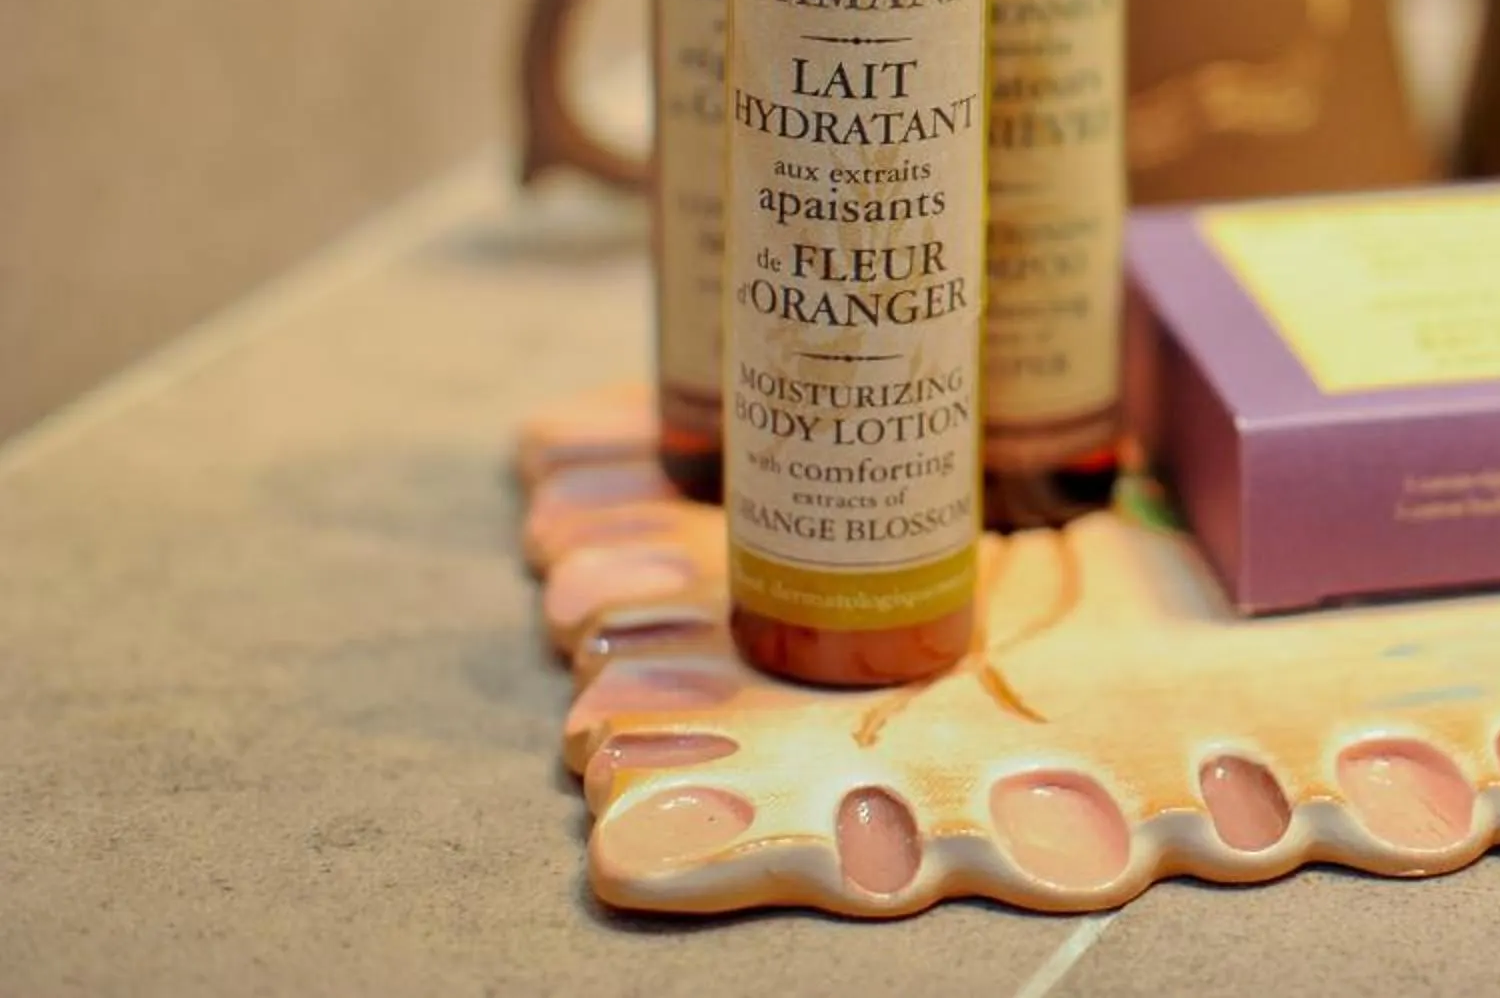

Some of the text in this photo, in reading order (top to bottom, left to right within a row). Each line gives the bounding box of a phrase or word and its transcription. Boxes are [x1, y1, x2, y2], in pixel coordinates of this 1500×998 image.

[792, 57, 918, 100] LAIT
[734, 88, 977, 146] HYDRATANT
[774, 159, 933, 185] aux extraits
[758, 186, 947, 228] apaisants
[757, 247, 782, 273] de
[792, 240, 947, 283] FLEUR
[736, 276, 968, 328] d'ORANGER
[740, 359, 964, 410] MOISTURIZING
[734, 389, 970, 446] BODY LOTION
[746, 450, 955, 485] with comforting
[792, 485, 909, 509] extracts of
[737, 495, 836, 543] RANGE
